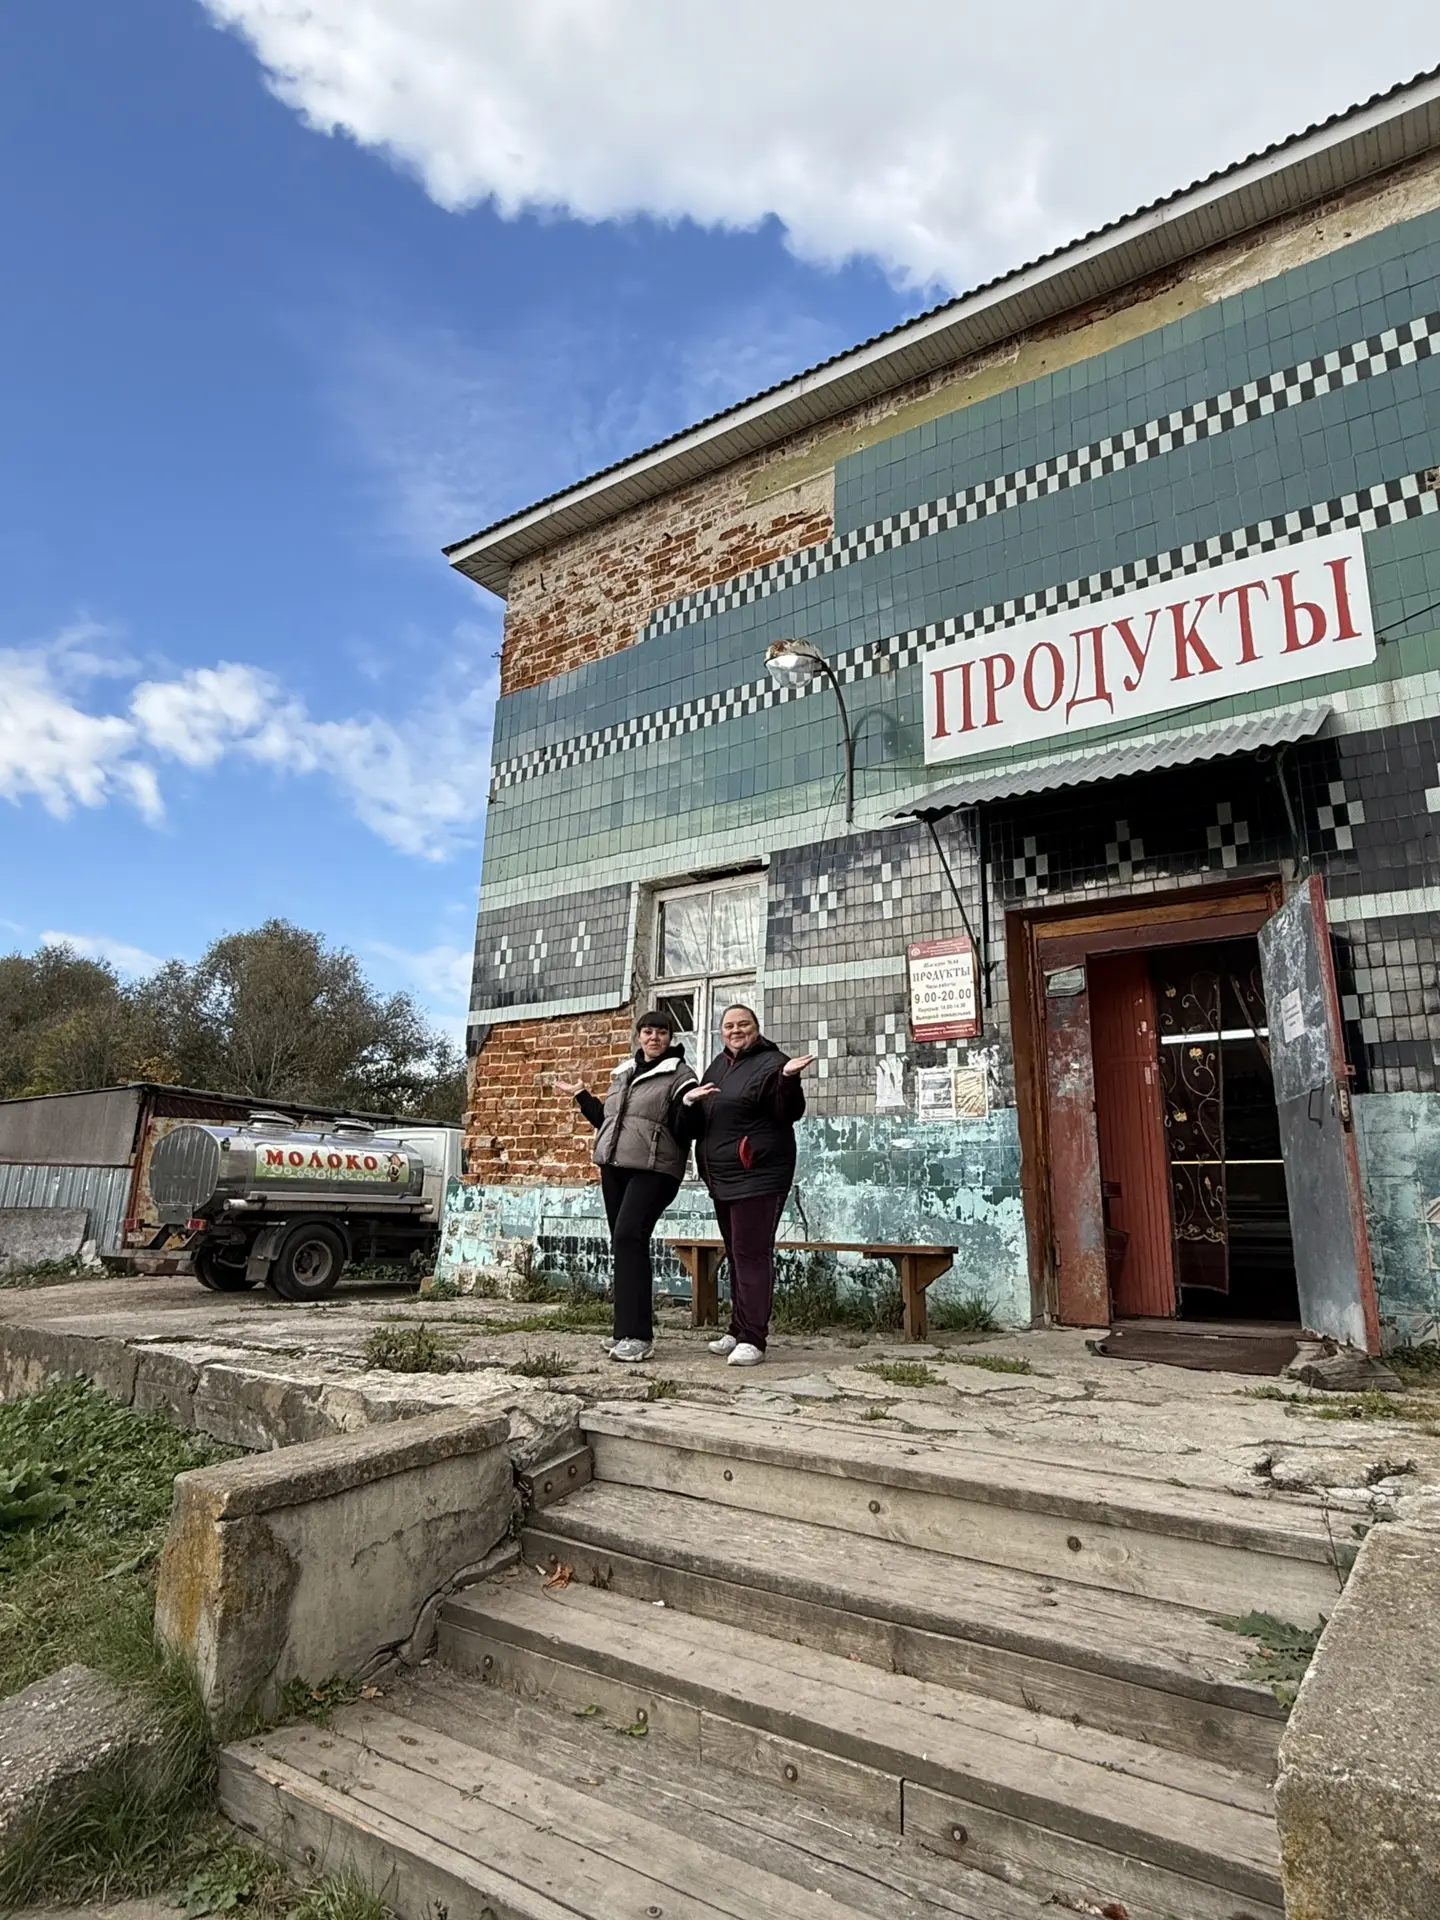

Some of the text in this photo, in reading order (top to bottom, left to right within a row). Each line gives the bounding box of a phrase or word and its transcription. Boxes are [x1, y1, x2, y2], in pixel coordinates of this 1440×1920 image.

[930, 556, 1362, 739] ПРОДУКТЫ
[912, 966, 970, 982] ПРОДУКТЫ
[914, 988, 971, 1004] 9.00-20.00
[265, 1149, 378, 1171] МОЛОКО
